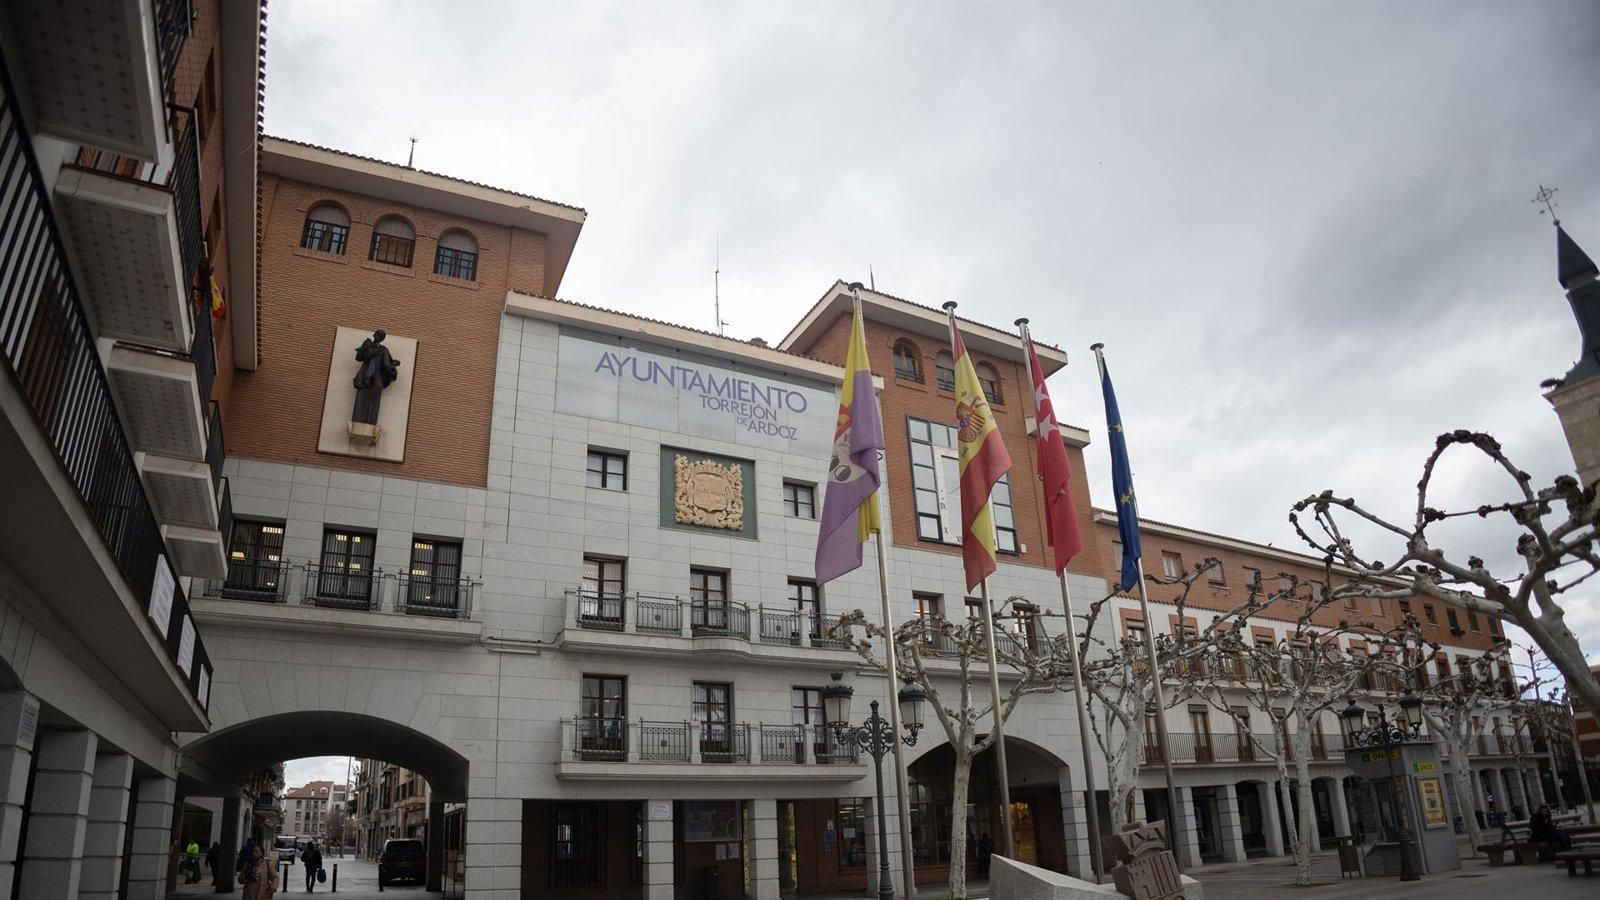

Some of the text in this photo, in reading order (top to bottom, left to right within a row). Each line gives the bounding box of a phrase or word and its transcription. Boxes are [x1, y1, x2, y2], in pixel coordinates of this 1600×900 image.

[594, 351, 808, 414] AYUNTAMIENTO
[699, 394, 777, 422] TORREJÓN
[736, 416, 799, 441] DE ARDOZ
[1419, 763, 1434, 771] ONCE
